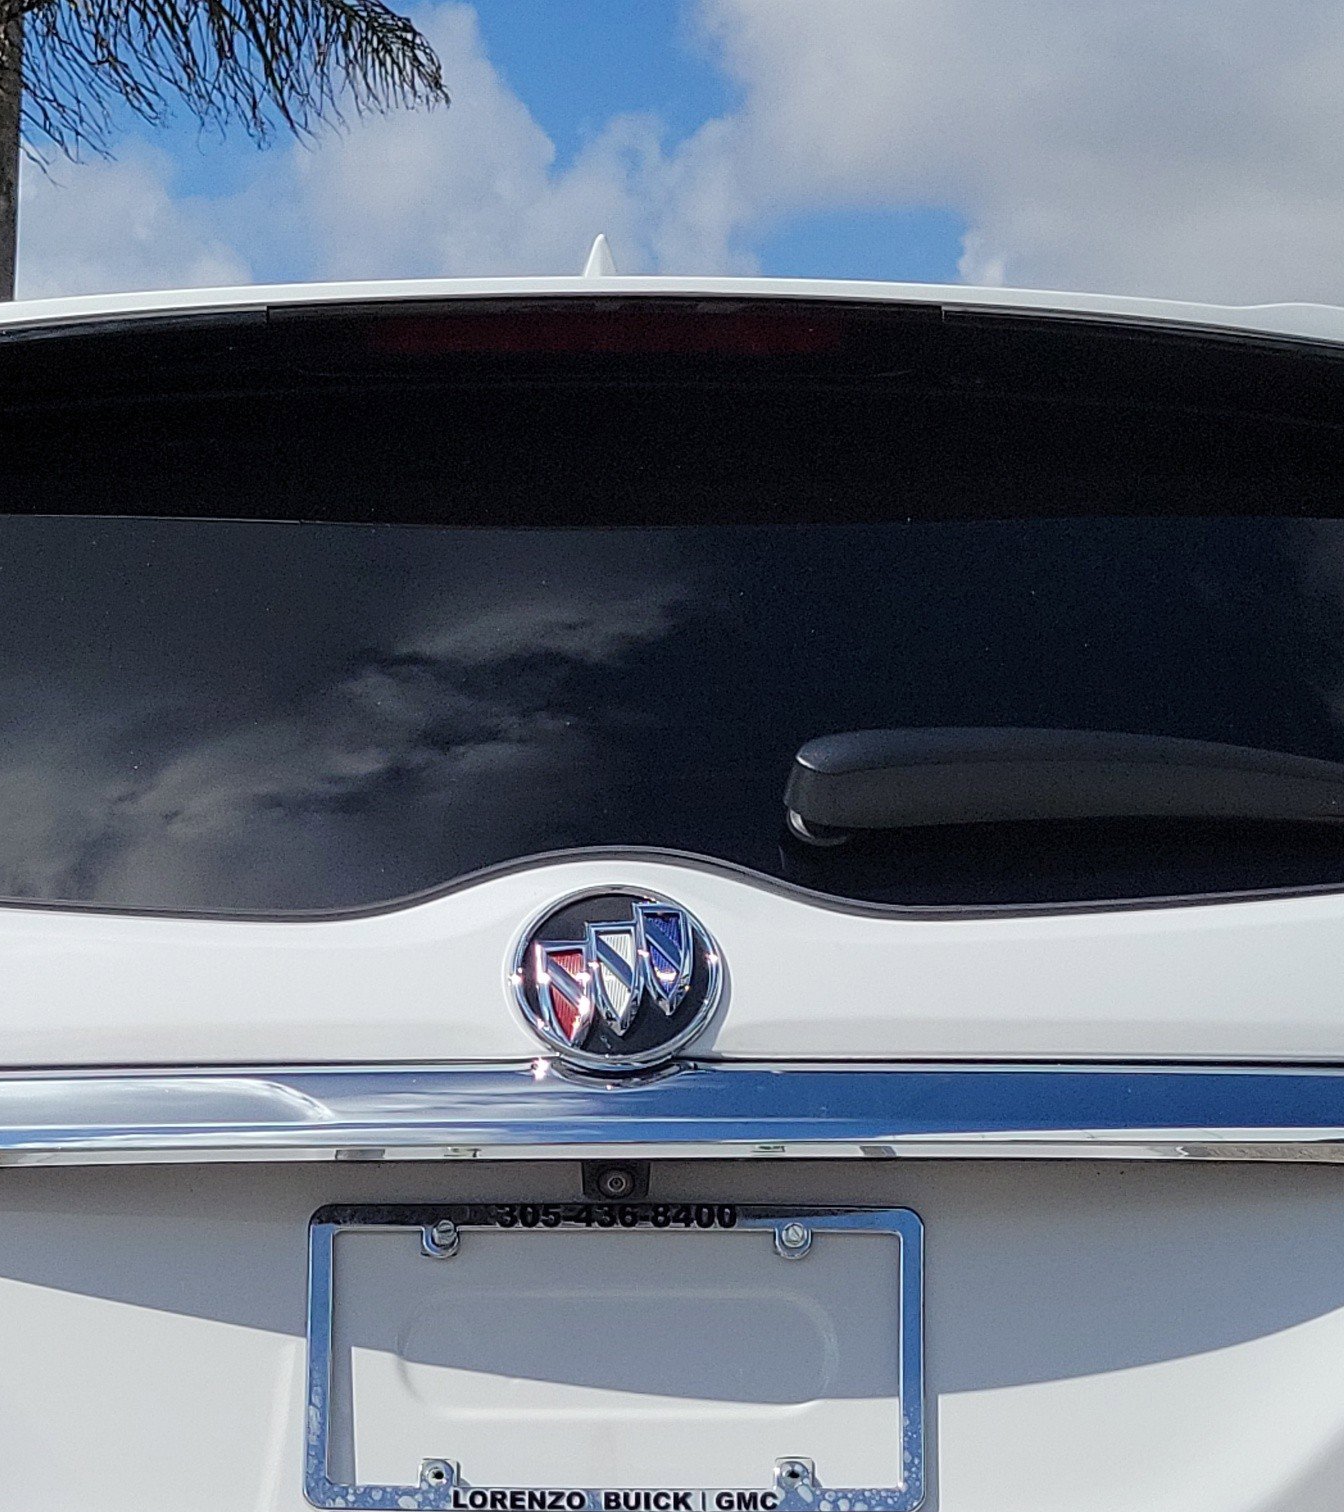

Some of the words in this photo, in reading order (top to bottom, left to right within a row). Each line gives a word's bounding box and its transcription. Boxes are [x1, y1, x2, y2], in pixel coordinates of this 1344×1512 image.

[495, 1203, 738, 1229] 305-436-8400
[452, 1489, 586, 1511] LORENZO
[603, 1491, 693, 1511] BUICK
[716, 1491, 778, 1512] GMC
